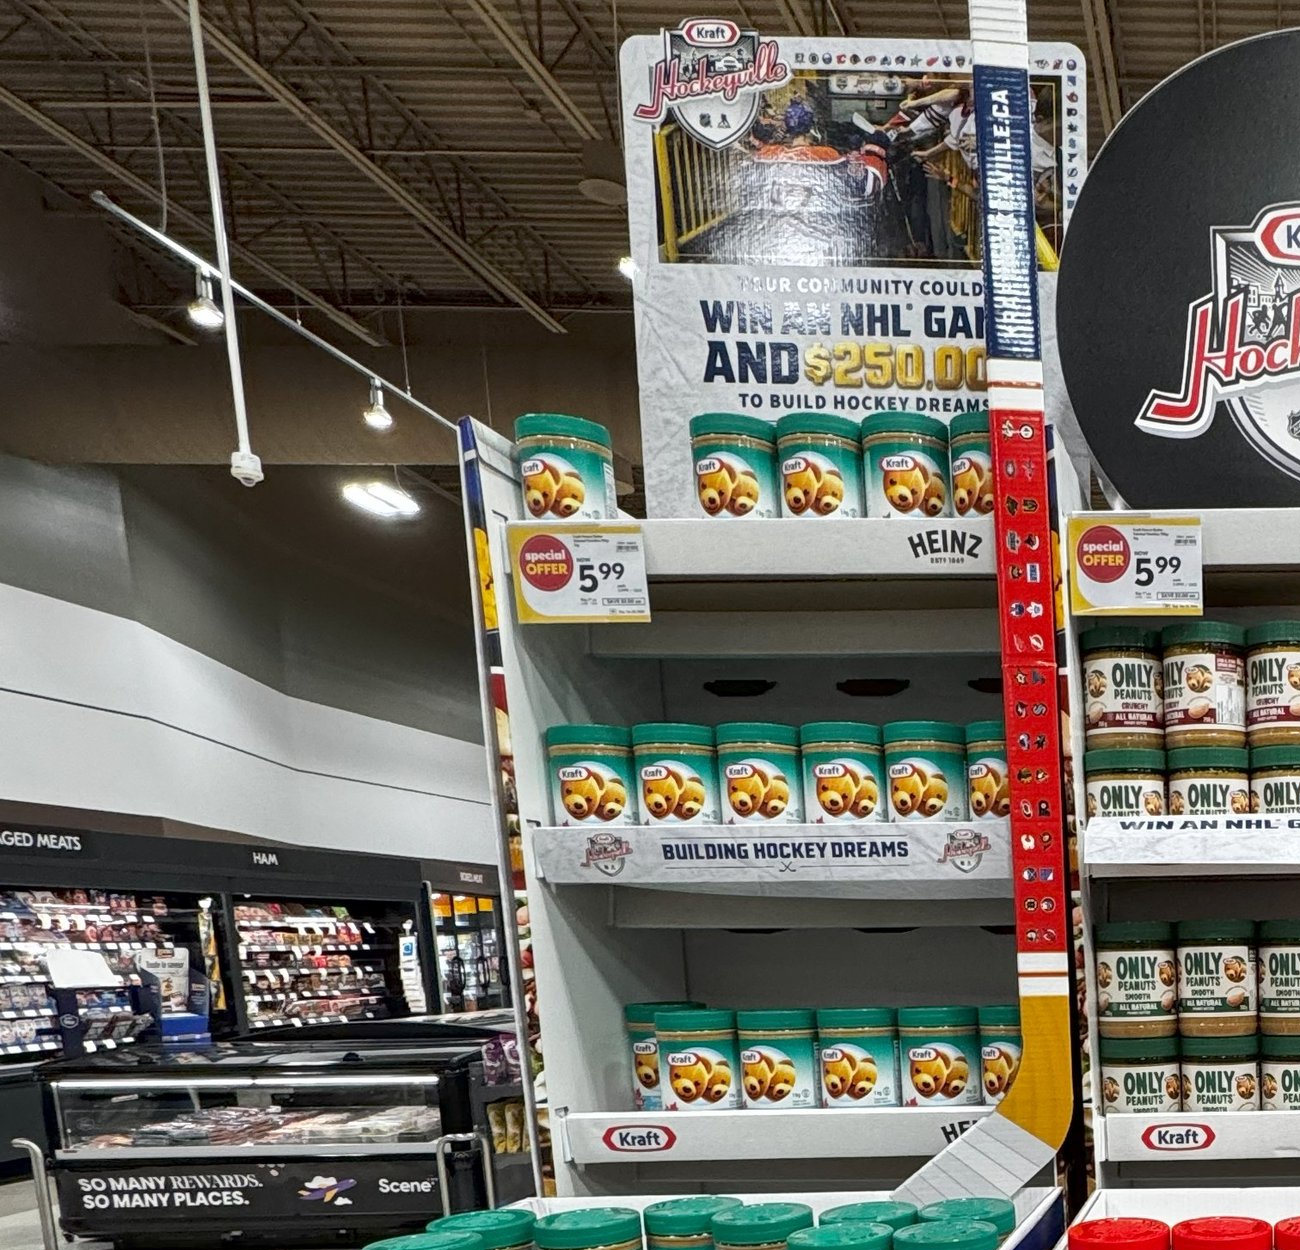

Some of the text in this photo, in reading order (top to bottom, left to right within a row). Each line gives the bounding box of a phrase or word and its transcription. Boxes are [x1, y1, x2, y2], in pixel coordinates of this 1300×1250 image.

[696, 26, 726, 40] Kraft
[634, 41, 787, 120] Hockeyville
[796, 278, 913, 296] COMMUNITY
[919, 280, 983, 296] COULD
[701, 300, 773, 334] WIN
[781, 302, 832, 336] AN
[703, 340, 800, 384] AND
[739, 393, 765, 409] TO
[770, 394, 826, 410] BUILD
[833, 395, 909, 411] HOCKEY
[908, 530, 982, 558] HEINZ
[1083, 541, 1123, 552] special
[525, 549, 565, 562] special
[1083, 555, 1124, 566] OFFER
[526, 563, 568, 575] OFFER
[1112, 663, 1153, 688] ONLY
[1114, 688, 1152, 701] PEANUTS
[561, 768, 583, 779] Kraft
[1120, 820, 1174, 830] WIN
[1179, 820, 1218, 830] AN
[0, 831, 82, 850] GED MEATS
[253, 852, 279, 866] HAM
[662, 841, 909, 860] BUILDING HOCKEY DREAMS
[1116, 957, 1157, 980] ONLY
[1118, 980, 1156, 992] PEANUTS
[618, 1131, 661, 1148] Kraft
[1157, 1129, 1200, 1146] Kraft
[78, 1174, 263, 1192] SO MANY REWARDS.
[83, 1191, 250, 1209] SO MANY PLACES.
